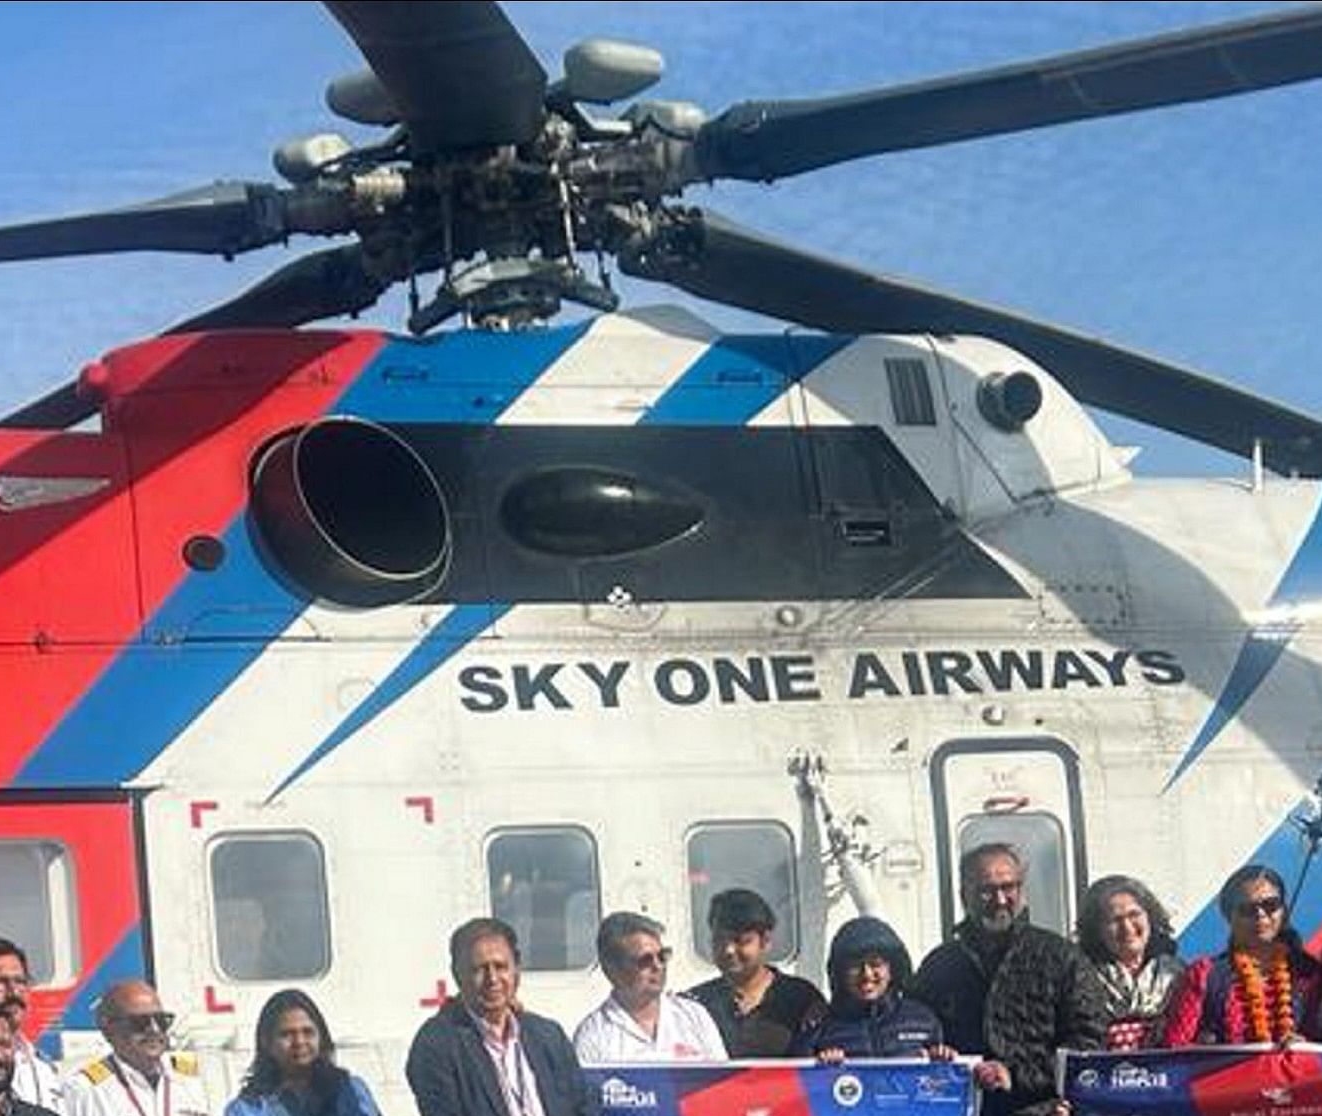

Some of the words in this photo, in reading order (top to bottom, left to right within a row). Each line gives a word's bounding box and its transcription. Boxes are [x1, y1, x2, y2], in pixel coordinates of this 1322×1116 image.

[457, 660, 631, 712] SKY
[653, 654, 821, 705] ONE
[847, 649, 1186, 699] AIRWAYS
